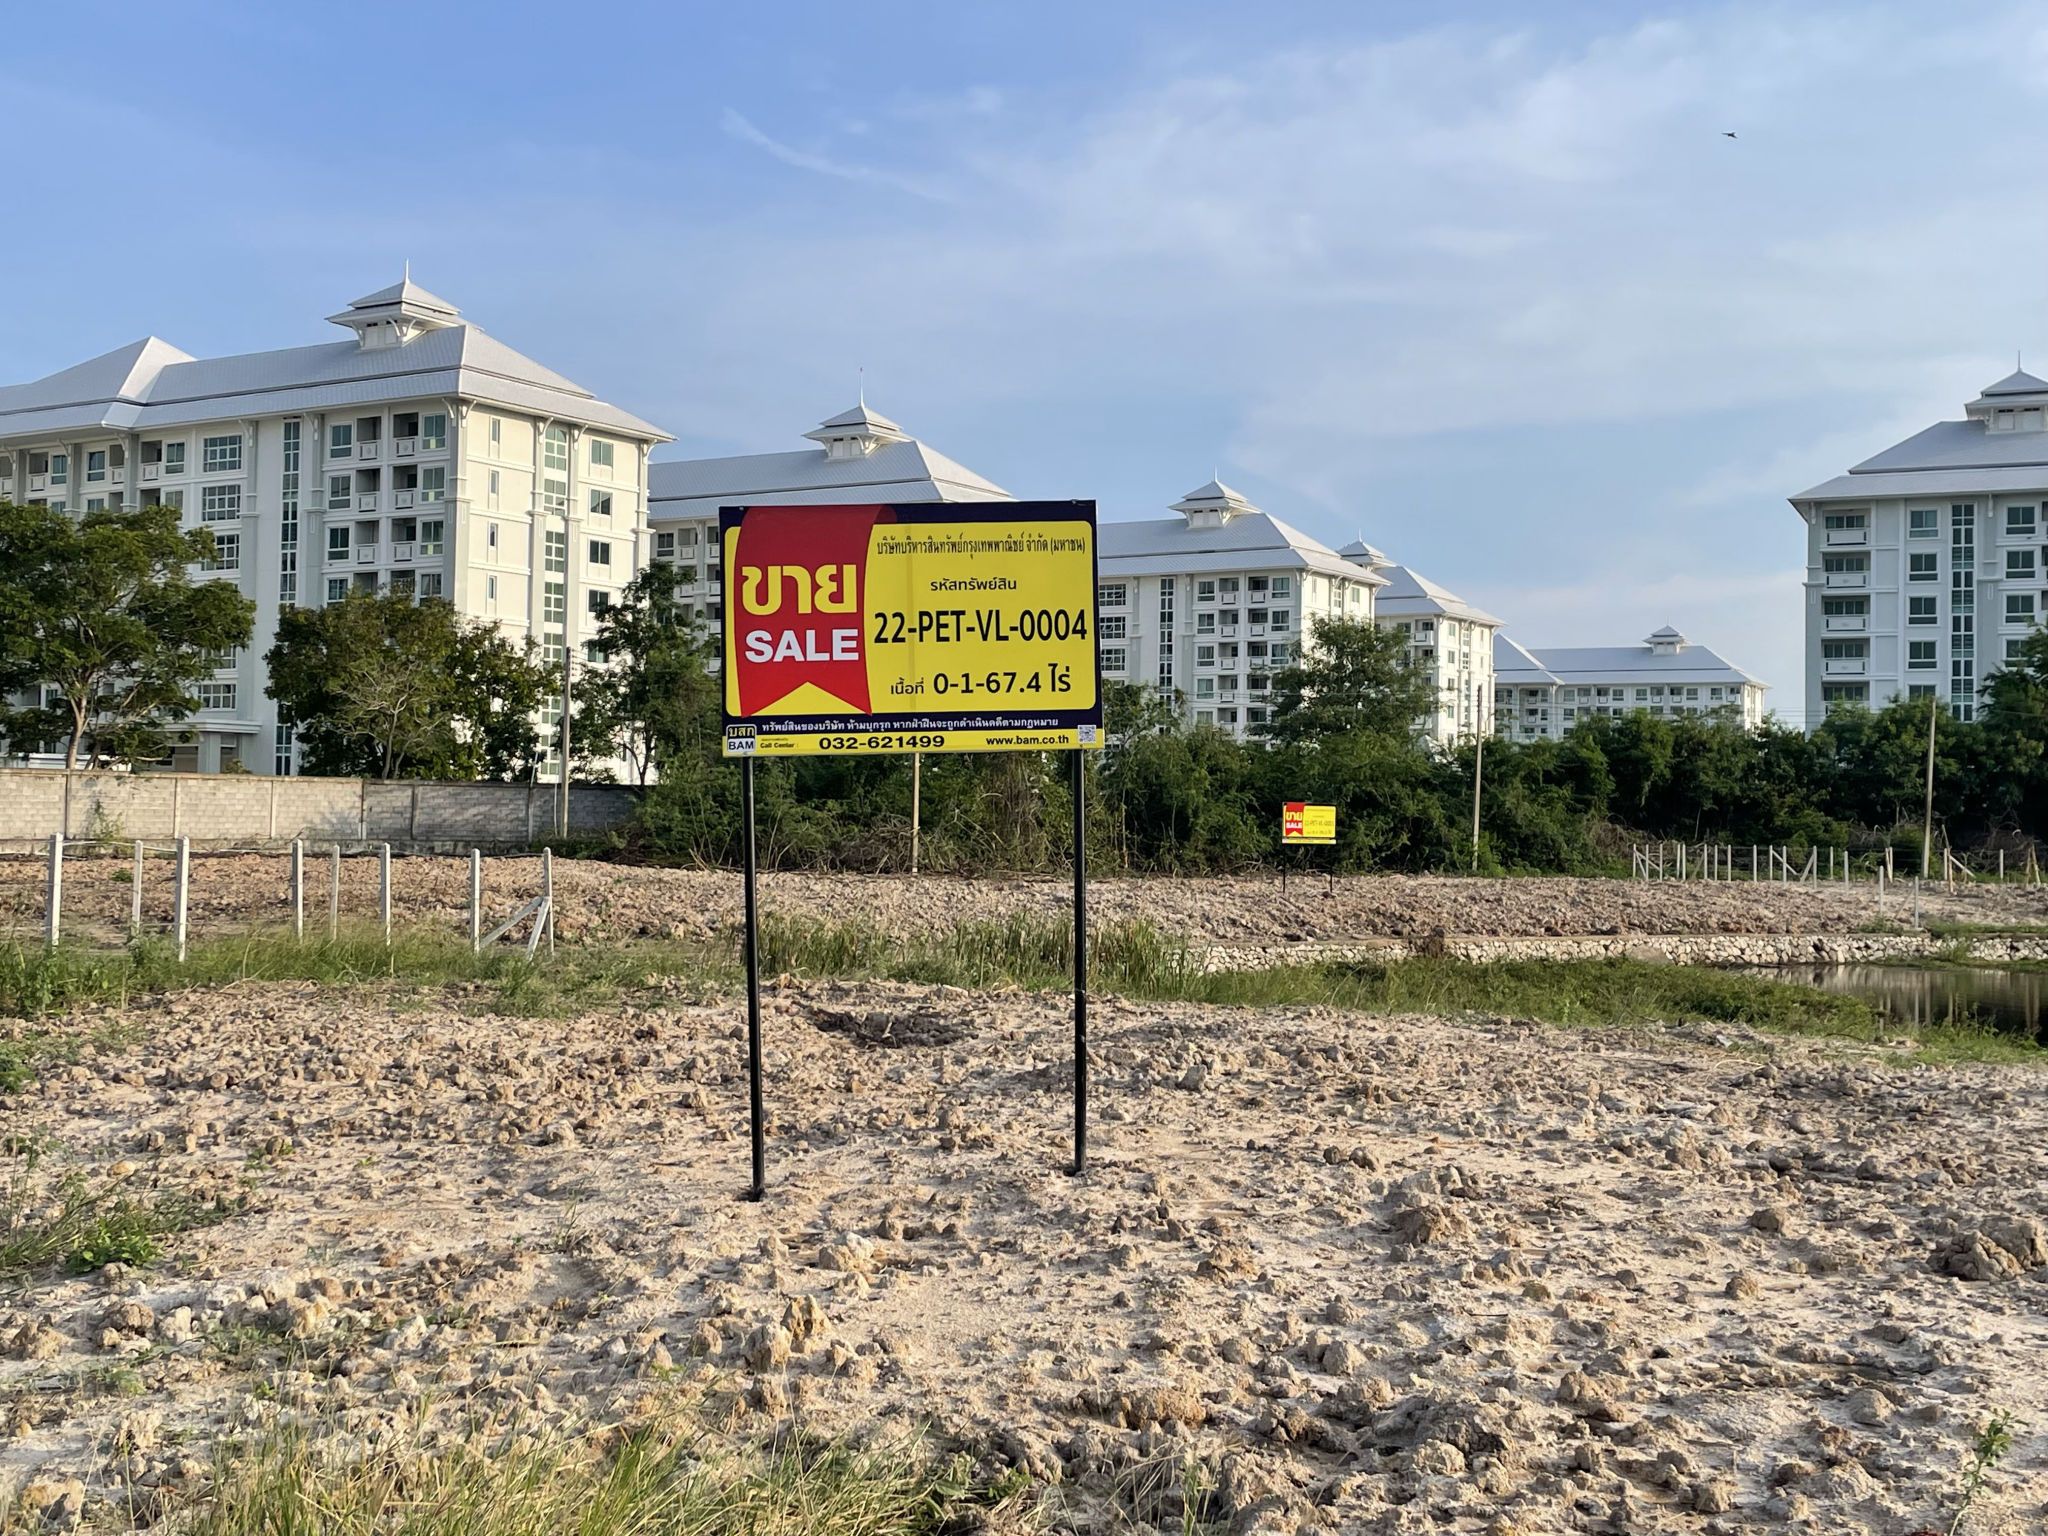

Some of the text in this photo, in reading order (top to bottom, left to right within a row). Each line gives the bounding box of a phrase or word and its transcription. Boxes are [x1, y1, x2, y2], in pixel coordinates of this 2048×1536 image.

[877, 532, 1086, 559] บริษัทบริหารสินทรัพย์กรุงเทพพาณิชย์ จำกัด (มหาชน)
[742, 564, 857, 616] ขาย
[930, 577, 1017, 591] รหัสทรัพย์สิน
[874, 609, 1087, 643] 22-PET-VL-0004
[745, 628, 859, 663] SALE
[890, 663, 1071, 695] เนื้อที่ 0-1-67.4 ไร่
[729, 727, 755, 737] บสก
[762, 720, 845, 732] ทรัพย์สินของบริษัท
[847, 719, 891, 733] ห้ามบุกรุก
[728, 740, 754, 750] BAM
[819, 735, 945, 750] 032-621499
[986, 734, 1069, 745] www.bam.co.th
[1286, 811, 1303, 821] ขาย
